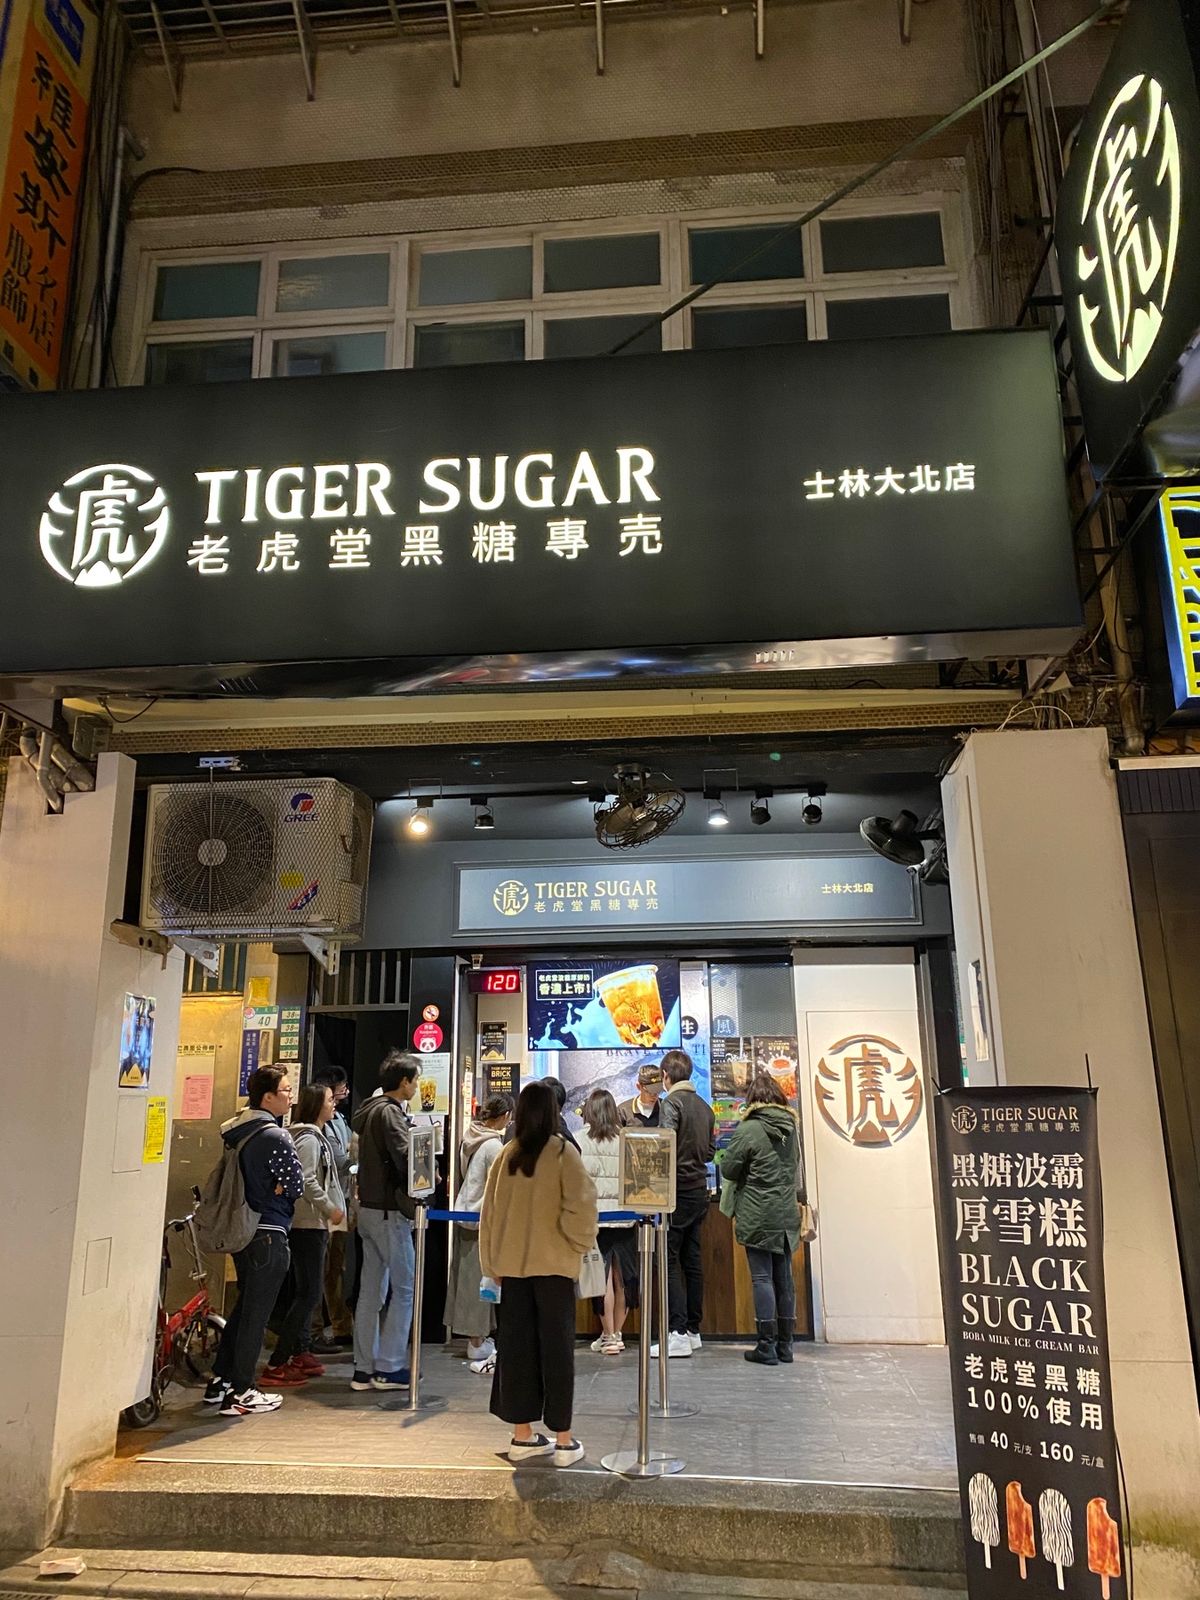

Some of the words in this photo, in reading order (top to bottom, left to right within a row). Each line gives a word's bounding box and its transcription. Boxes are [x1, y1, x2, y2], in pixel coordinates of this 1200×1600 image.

[195, 463, 396, 524] TIGER
[418, 447, 661, 513] SUGAR
[803, 462, 976, 500] 士林大北店
[187, 513, 663, 574] 老虎堂黑糖專売
[284, 813, 320, 822] GREE
[534, 882, 588, 898] TIGER
[594, 880, 658, 896] SUGAR
[820, 882, 874, 894] 士林大北店
[534, 898, 659, 913] 老虎堂黑糖專売
[487, 974, 517, 990] 120
[258, 1016, 271, 1026] 40
[681, 1019, 695, 1035] 生
[491, 1070, 511, 1078] BRICK
[981, 1107, 1023, 1121] TIGER
[1027, 1106, 1079, 1121] SUGAR
[951, 1152, 1084, 1190] 黑糖波霸
[955, 1195, 1088, 1248] 厚雪糕
[958, 1252, 1091, 1293] BLACK
[961, 1293, 1097, 1338] SUGAR
[962, 1331, 985, 1342] BOBA
[988, 1334, 1010, 1345] MILK
[1014, 1337, 1031, 1348] ICE
[1035, 1339, 1073, 1352] CREAM
[1078, 1344, 1100, 1355] BAR
[964, 1352, 1101, 1397] 老虎堂黑糖
[990, 1431, 1009, 1449] 40
[1040, 1441, 1074, 1462] 160
